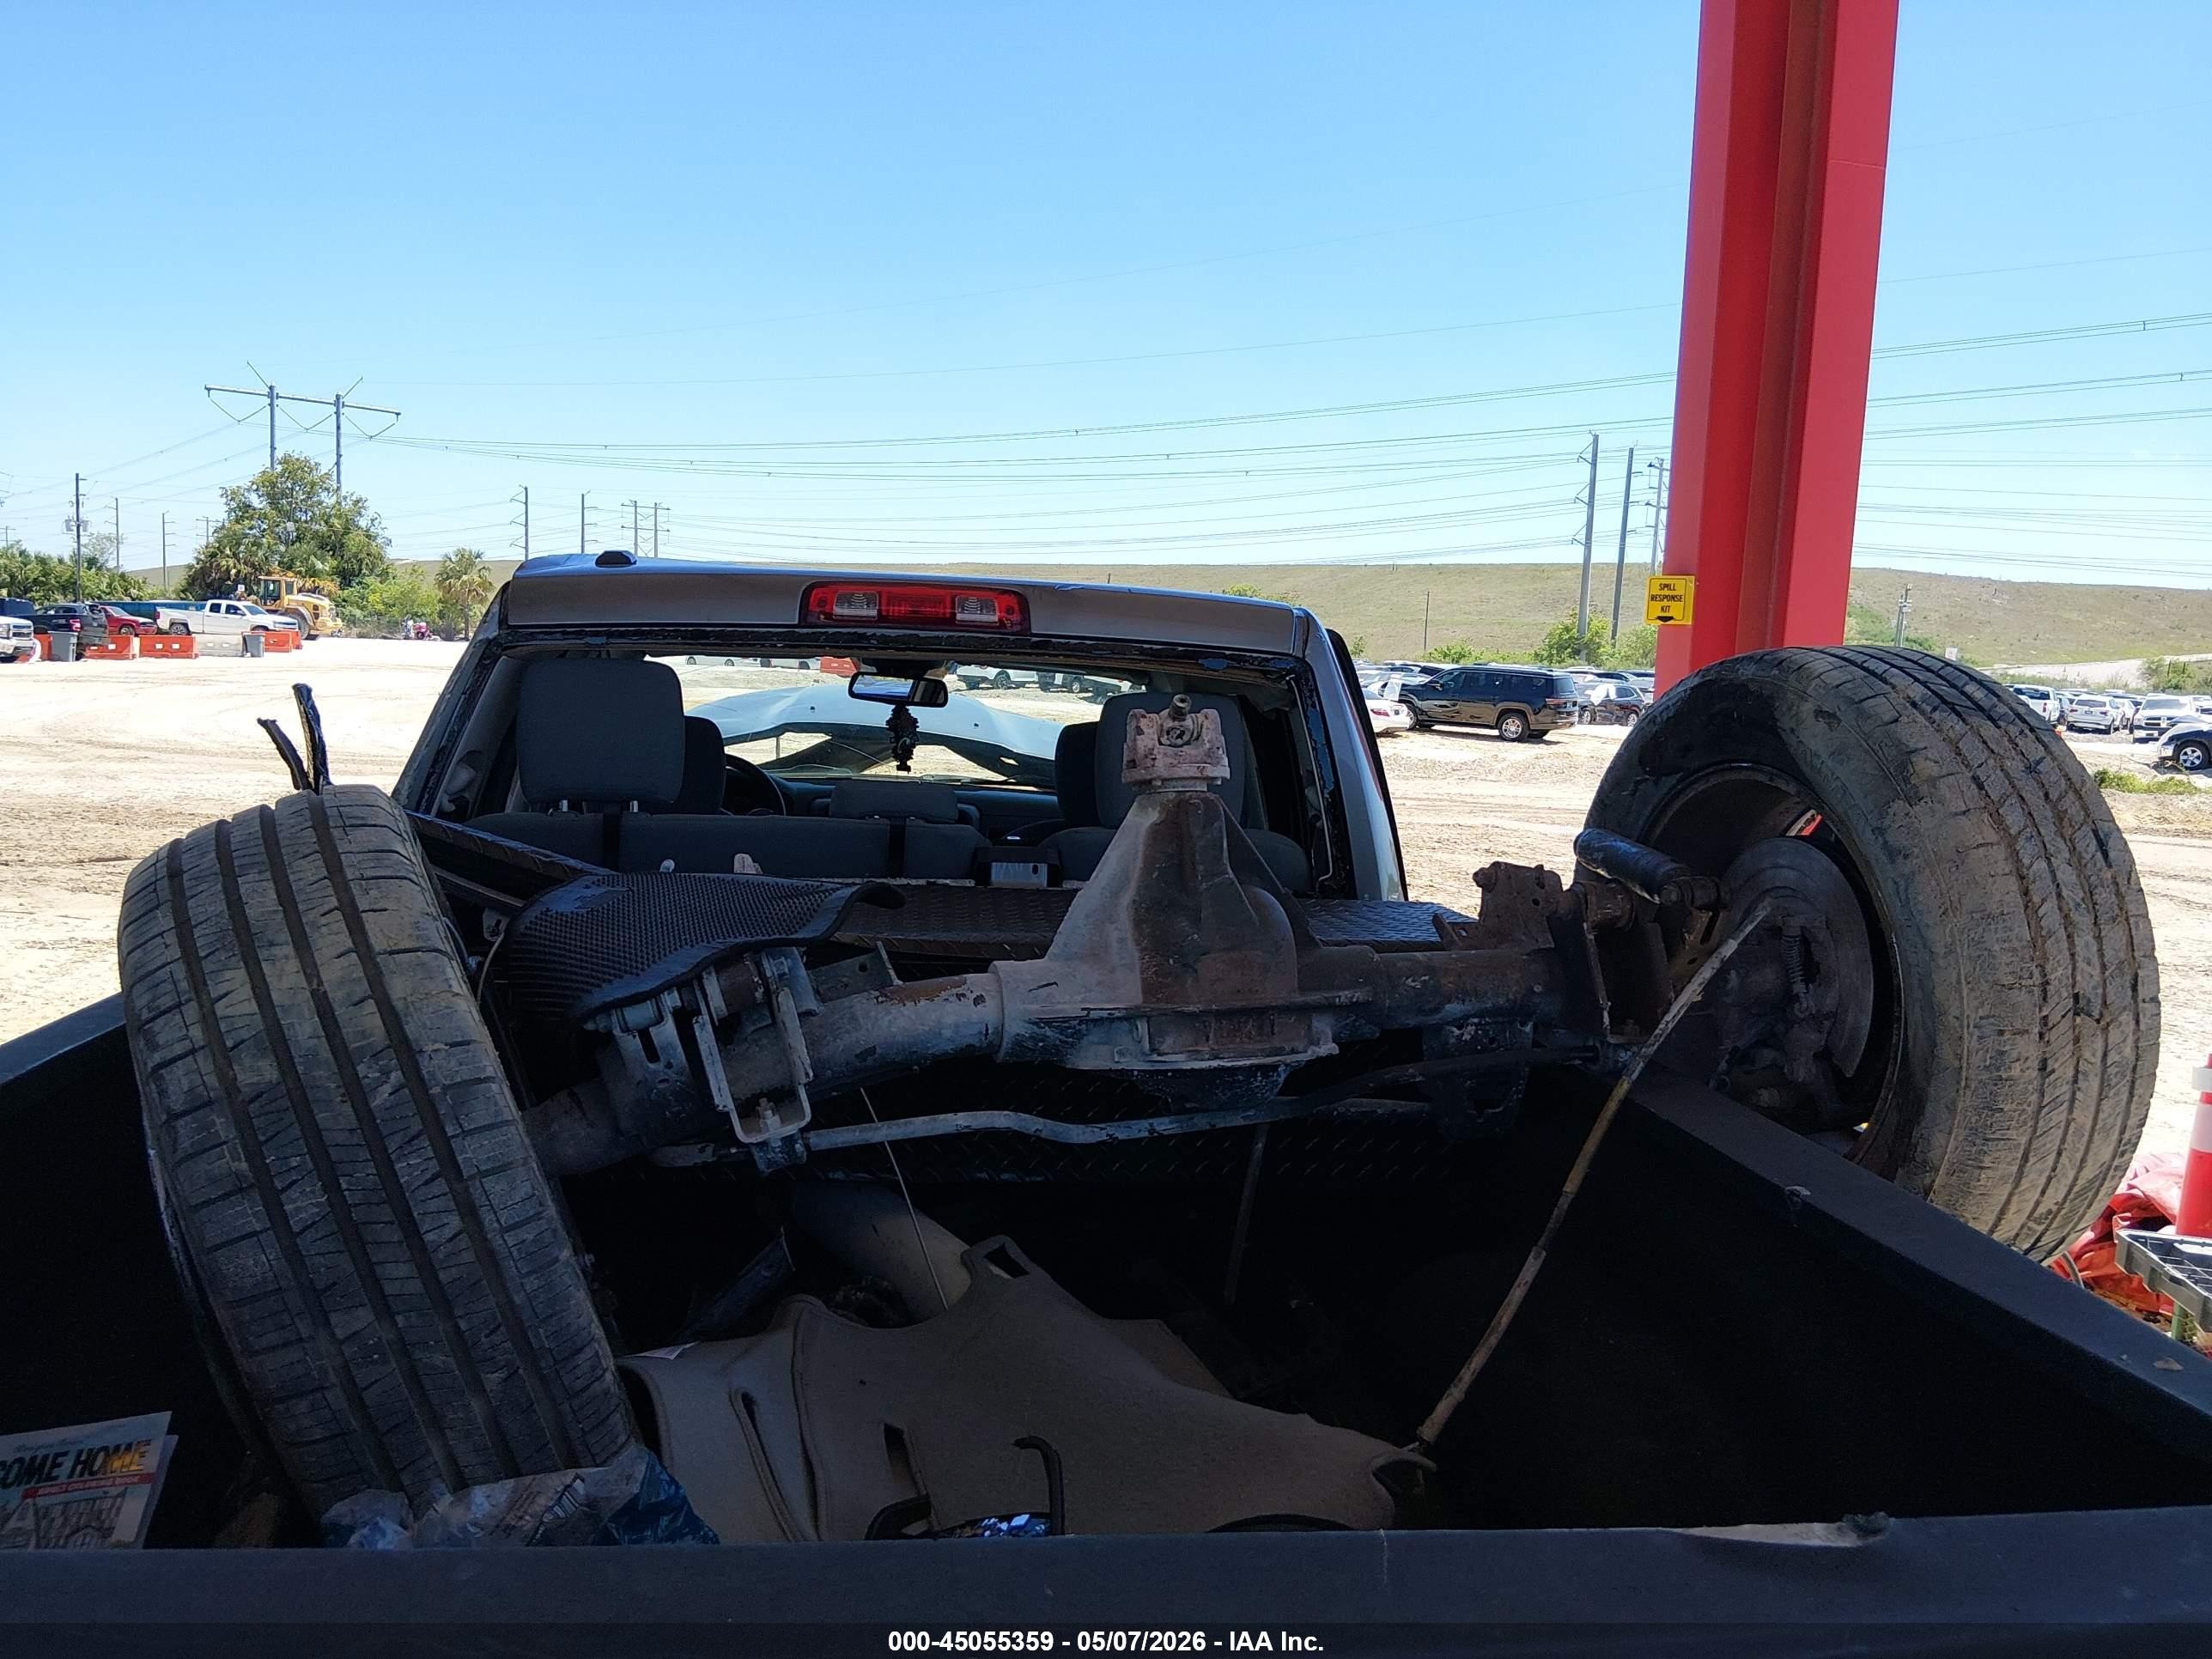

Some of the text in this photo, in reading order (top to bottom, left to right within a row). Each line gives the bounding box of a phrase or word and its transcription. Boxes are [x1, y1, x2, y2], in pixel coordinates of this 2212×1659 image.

[1650, 593, 1683, 602] RESPONSE
[1660, 605, 1671, 613] KIT
[68, 1439, 152, 1479] HOME
